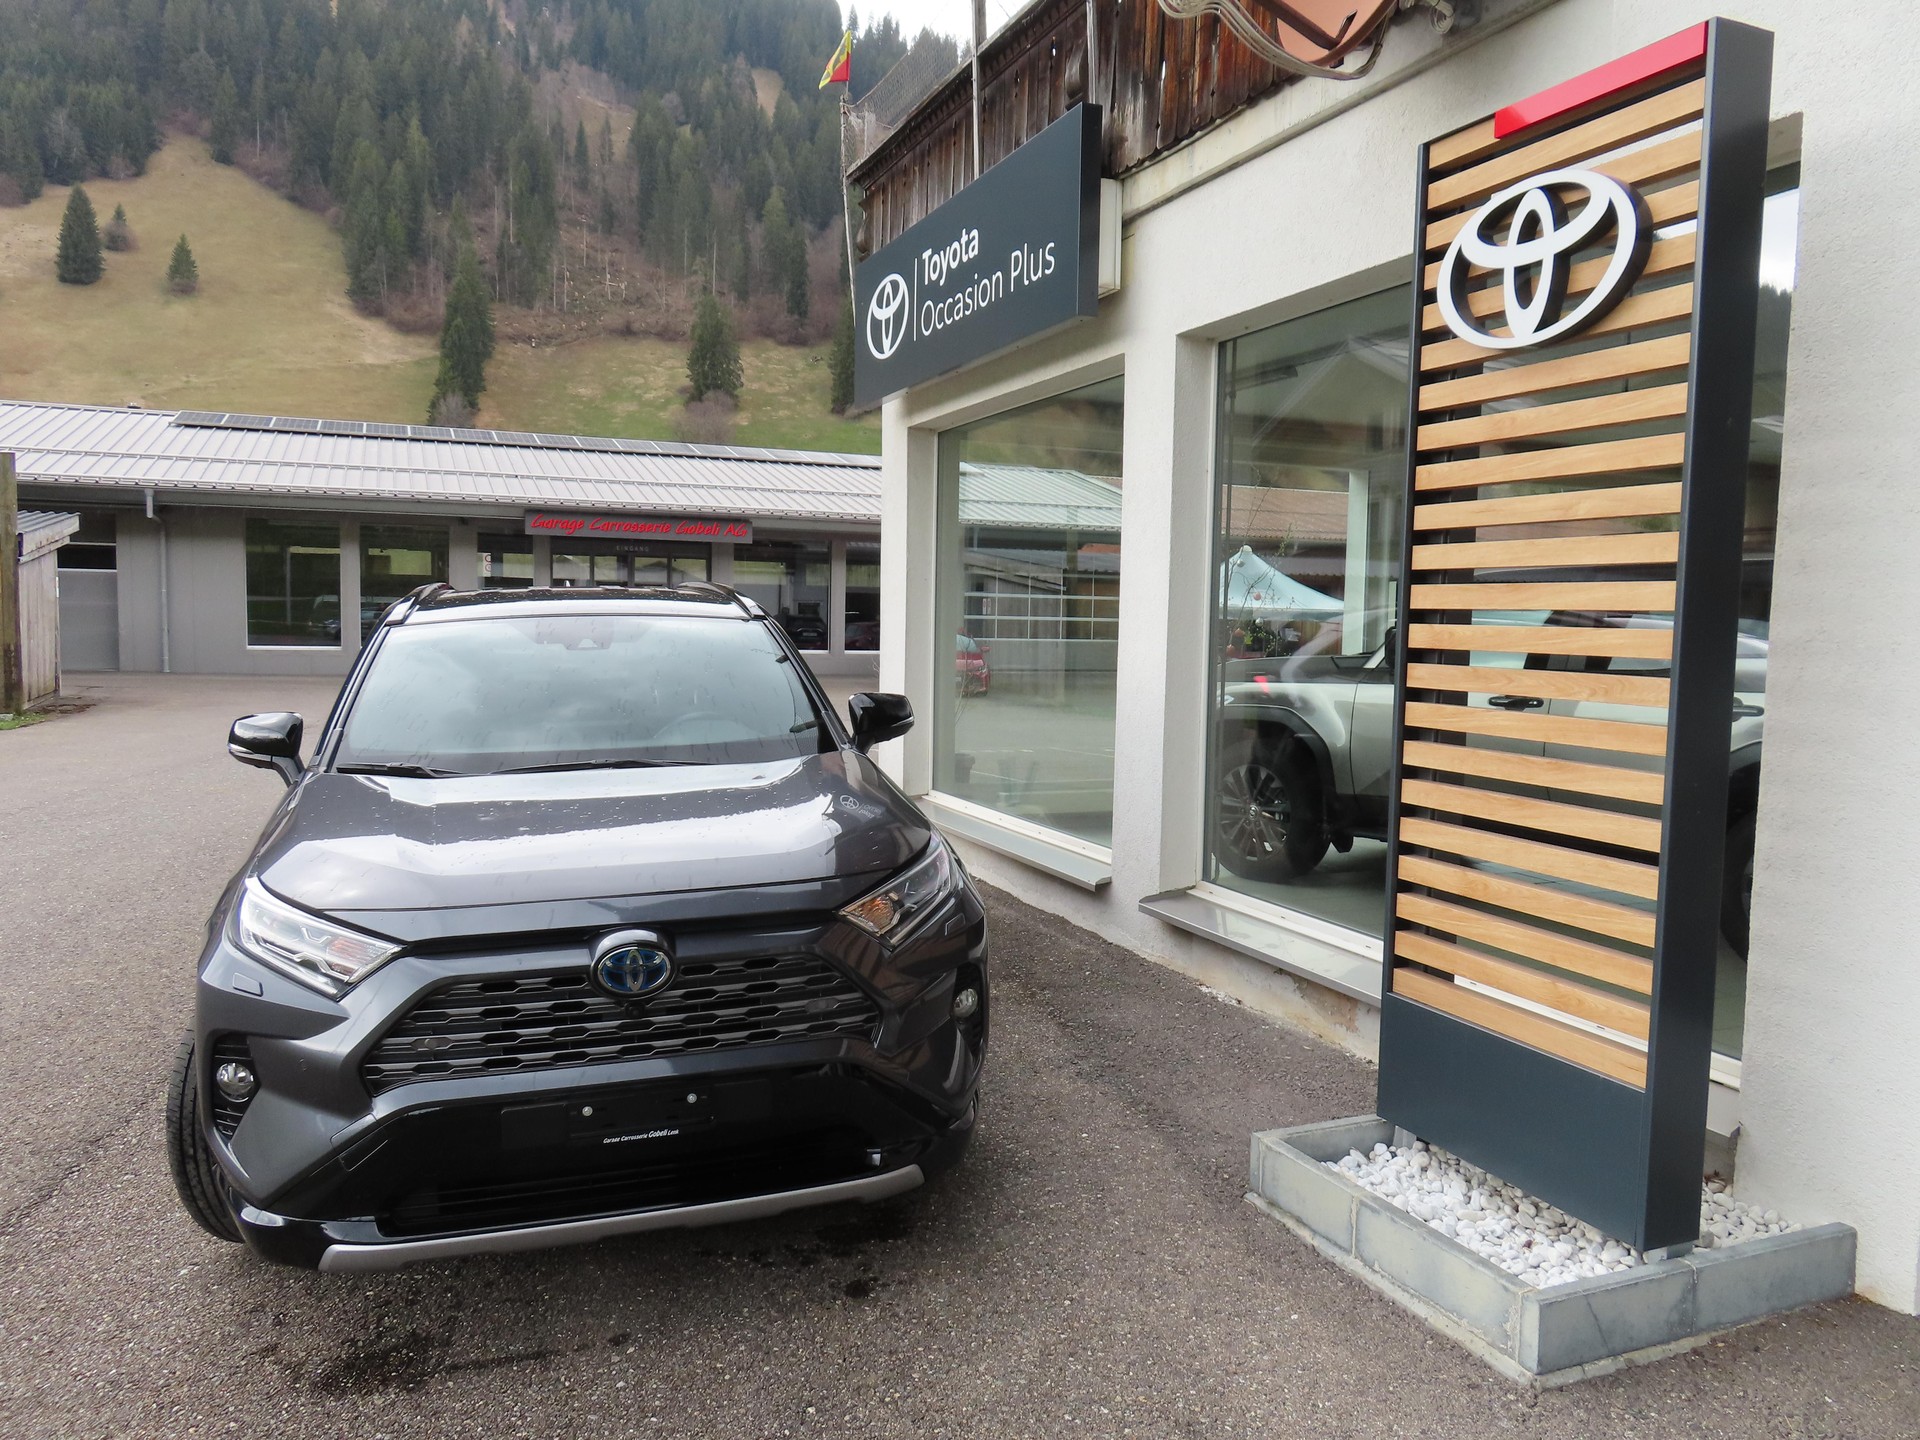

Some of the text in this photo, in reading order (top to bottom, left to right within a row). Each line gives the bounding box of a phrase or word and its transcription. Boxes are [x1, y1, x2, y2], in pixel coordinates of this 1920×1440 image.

[922, 228, 979, 287] Toyota
[921, 241, 1055, 336] Occasion Plus
[530, 513, 748, 537] Garage Carrosserie Gobeli AG
[648, 1129, 668, 1138] Gobeli
